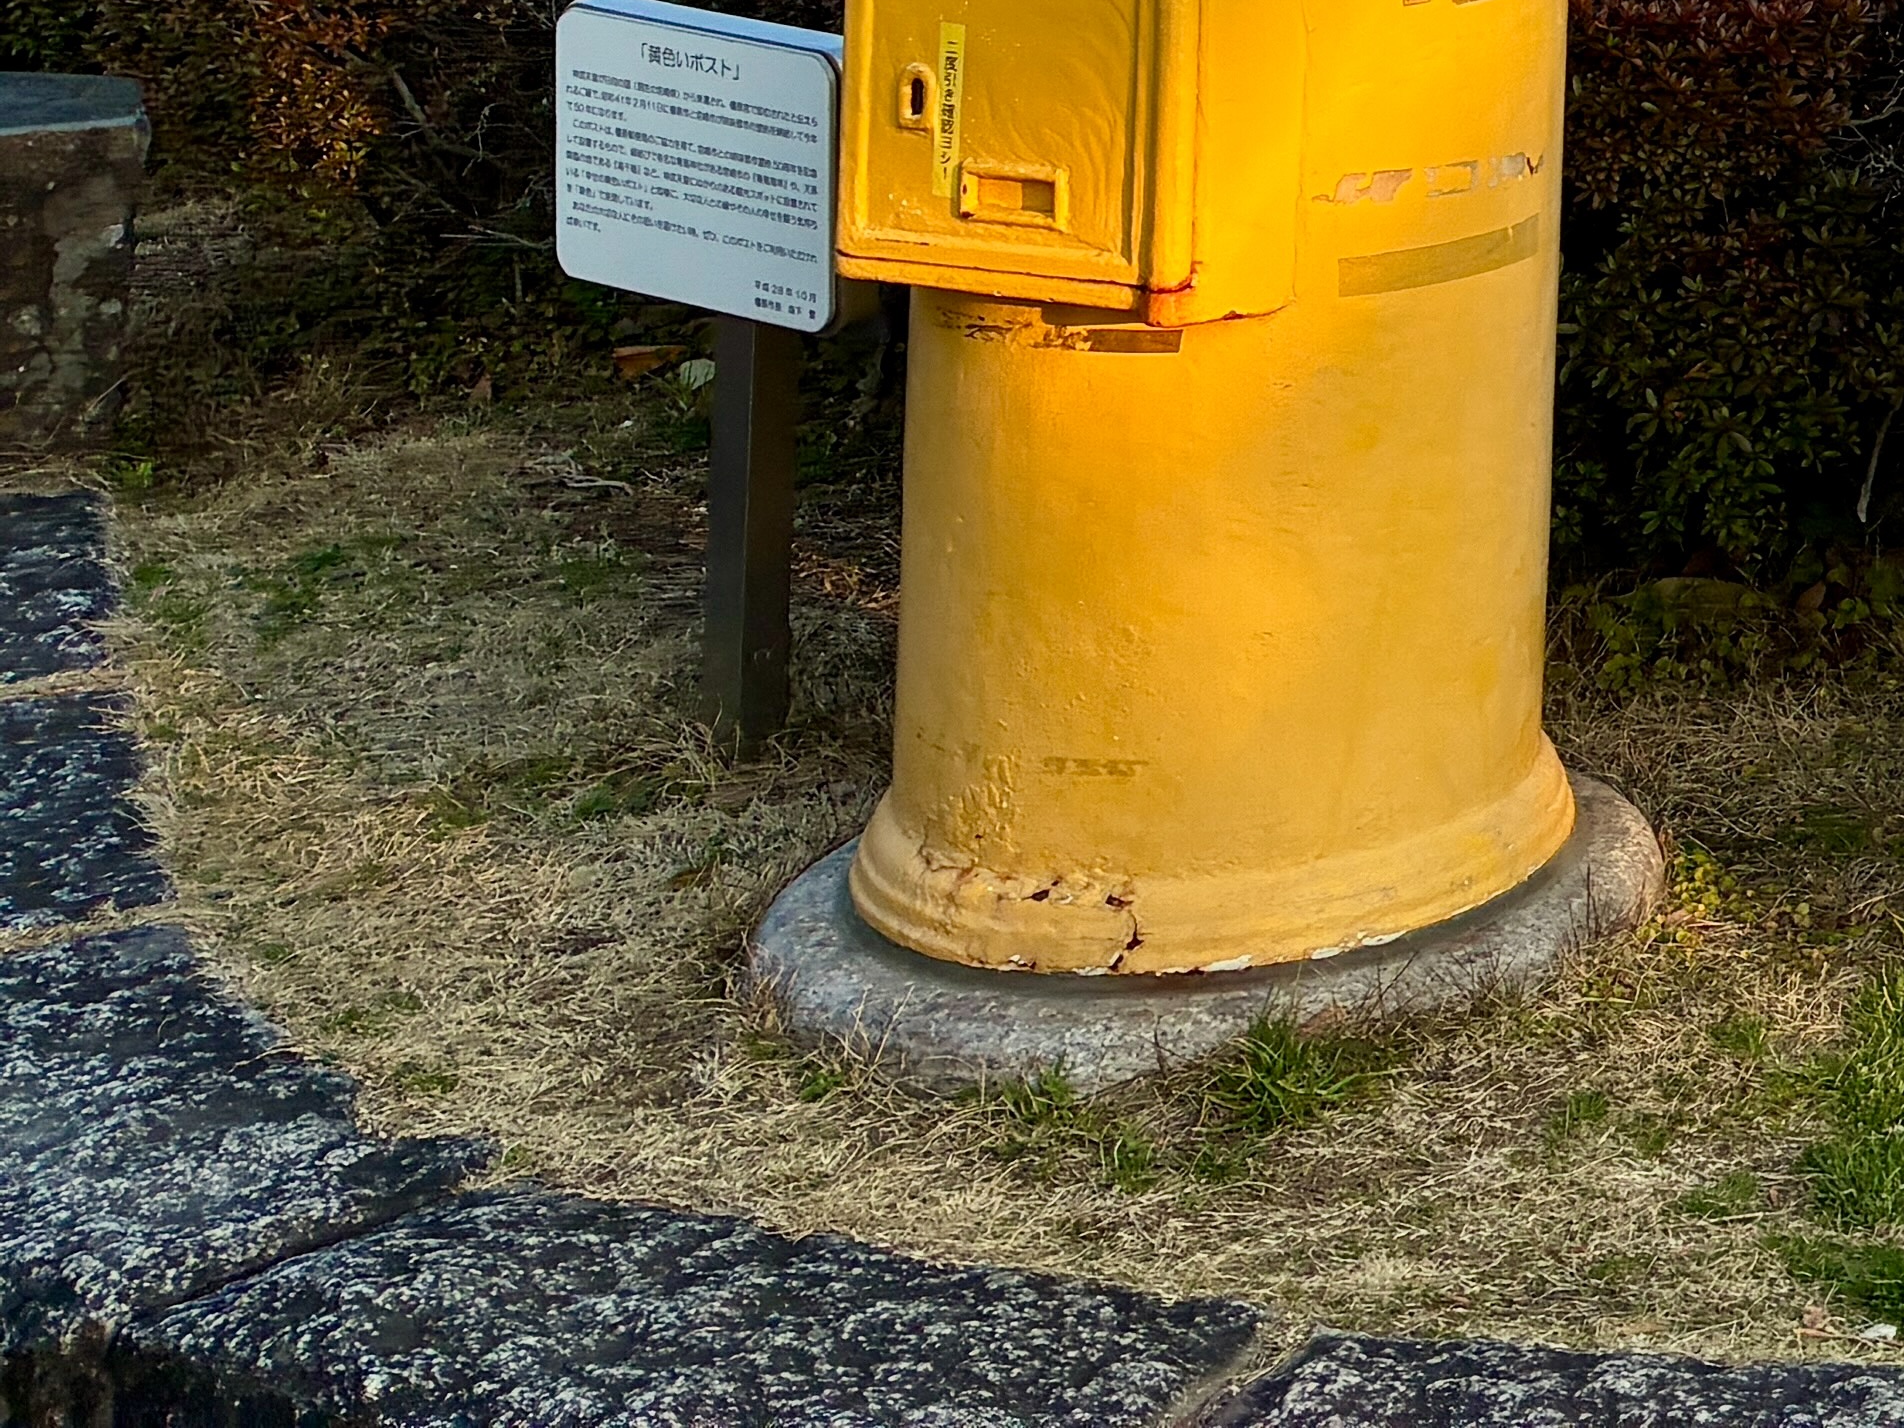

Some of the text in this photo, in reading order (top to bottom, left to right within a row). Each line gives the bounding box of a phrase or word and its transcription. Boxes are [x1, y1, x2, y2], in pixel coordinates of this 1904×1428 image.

[640, 42, 740, 81] 「黄色いポスト」
